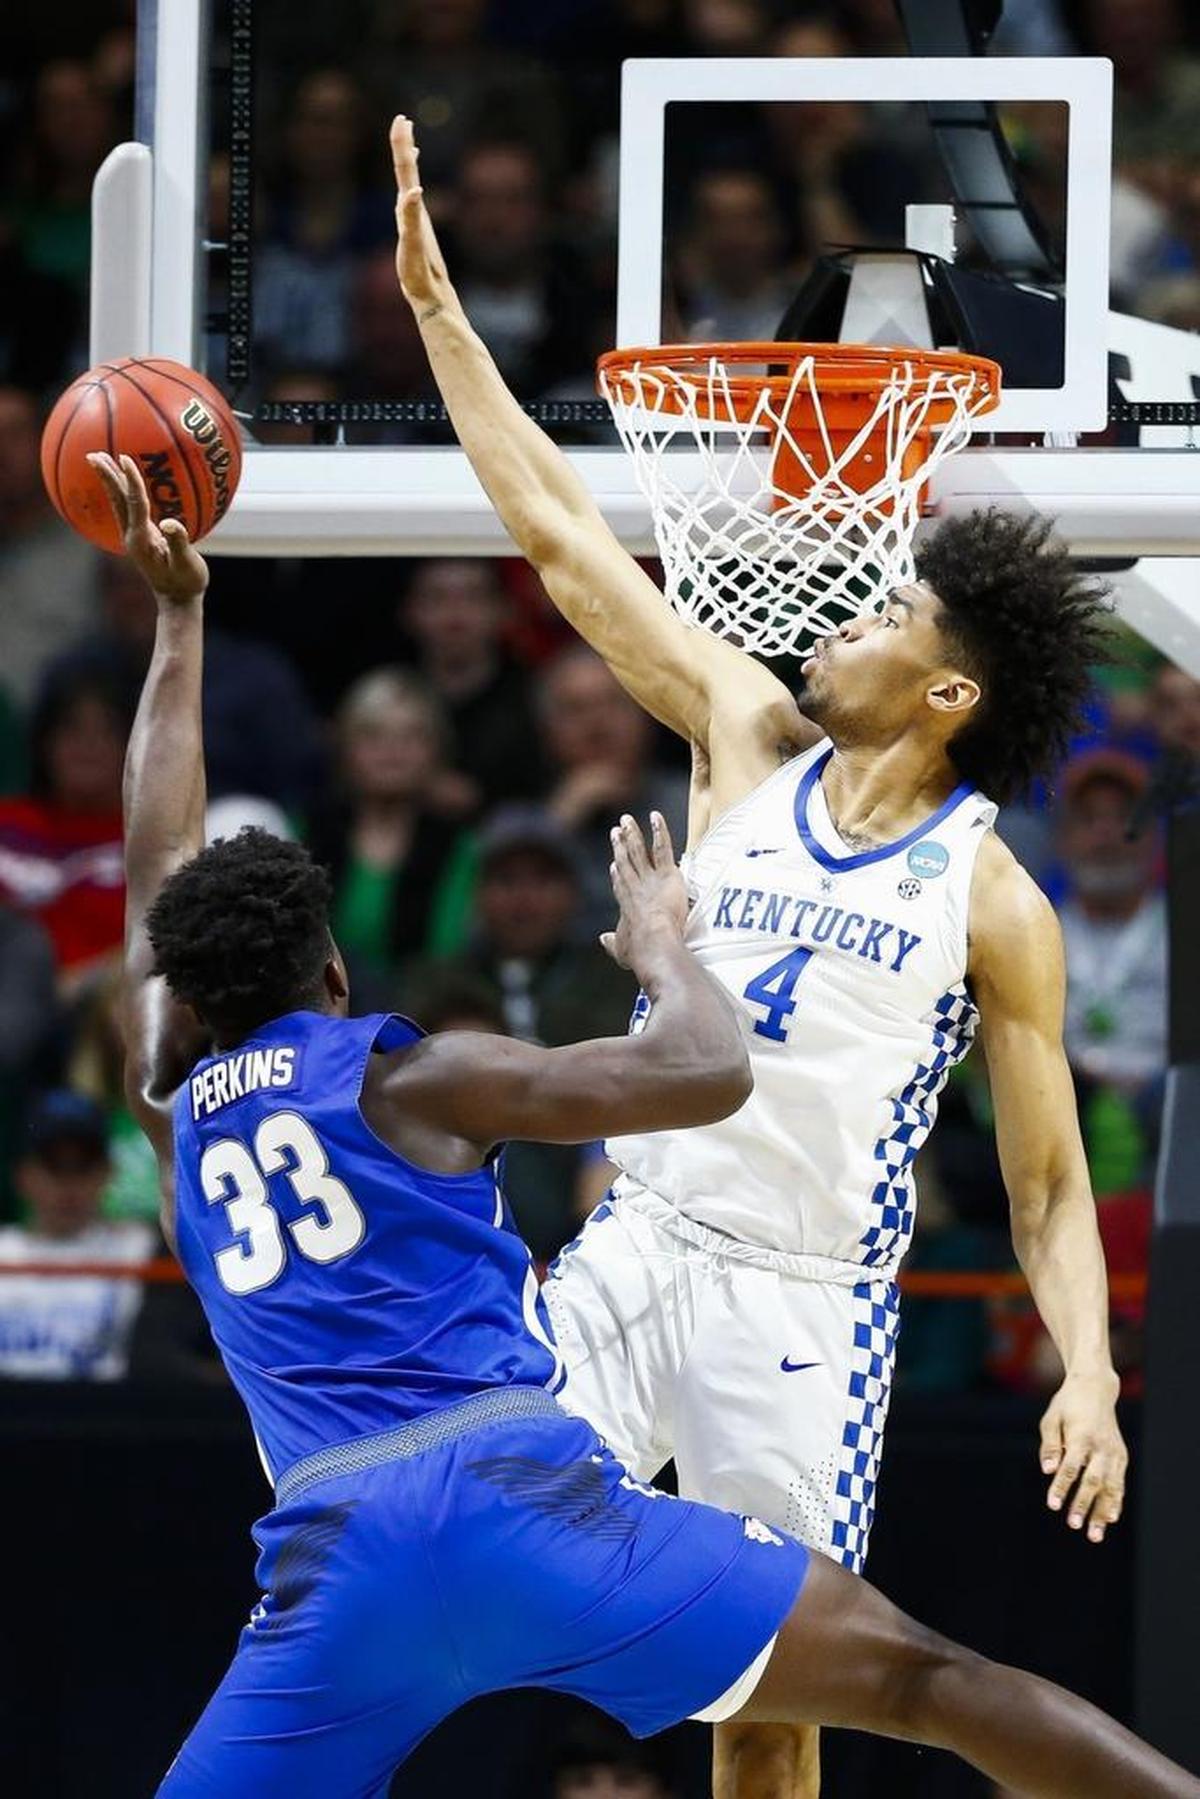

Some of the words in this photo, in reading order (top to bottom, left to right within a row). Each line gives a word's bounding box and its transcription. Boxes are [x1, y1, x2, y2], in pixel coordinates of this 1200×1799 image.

[713, 887, 922, 973] KENTUCKY
[743, 945, 815, 1043] 4
[191, 1047, 296, 1121] PERKINS
[200, 1110, 366, 1296] 33
